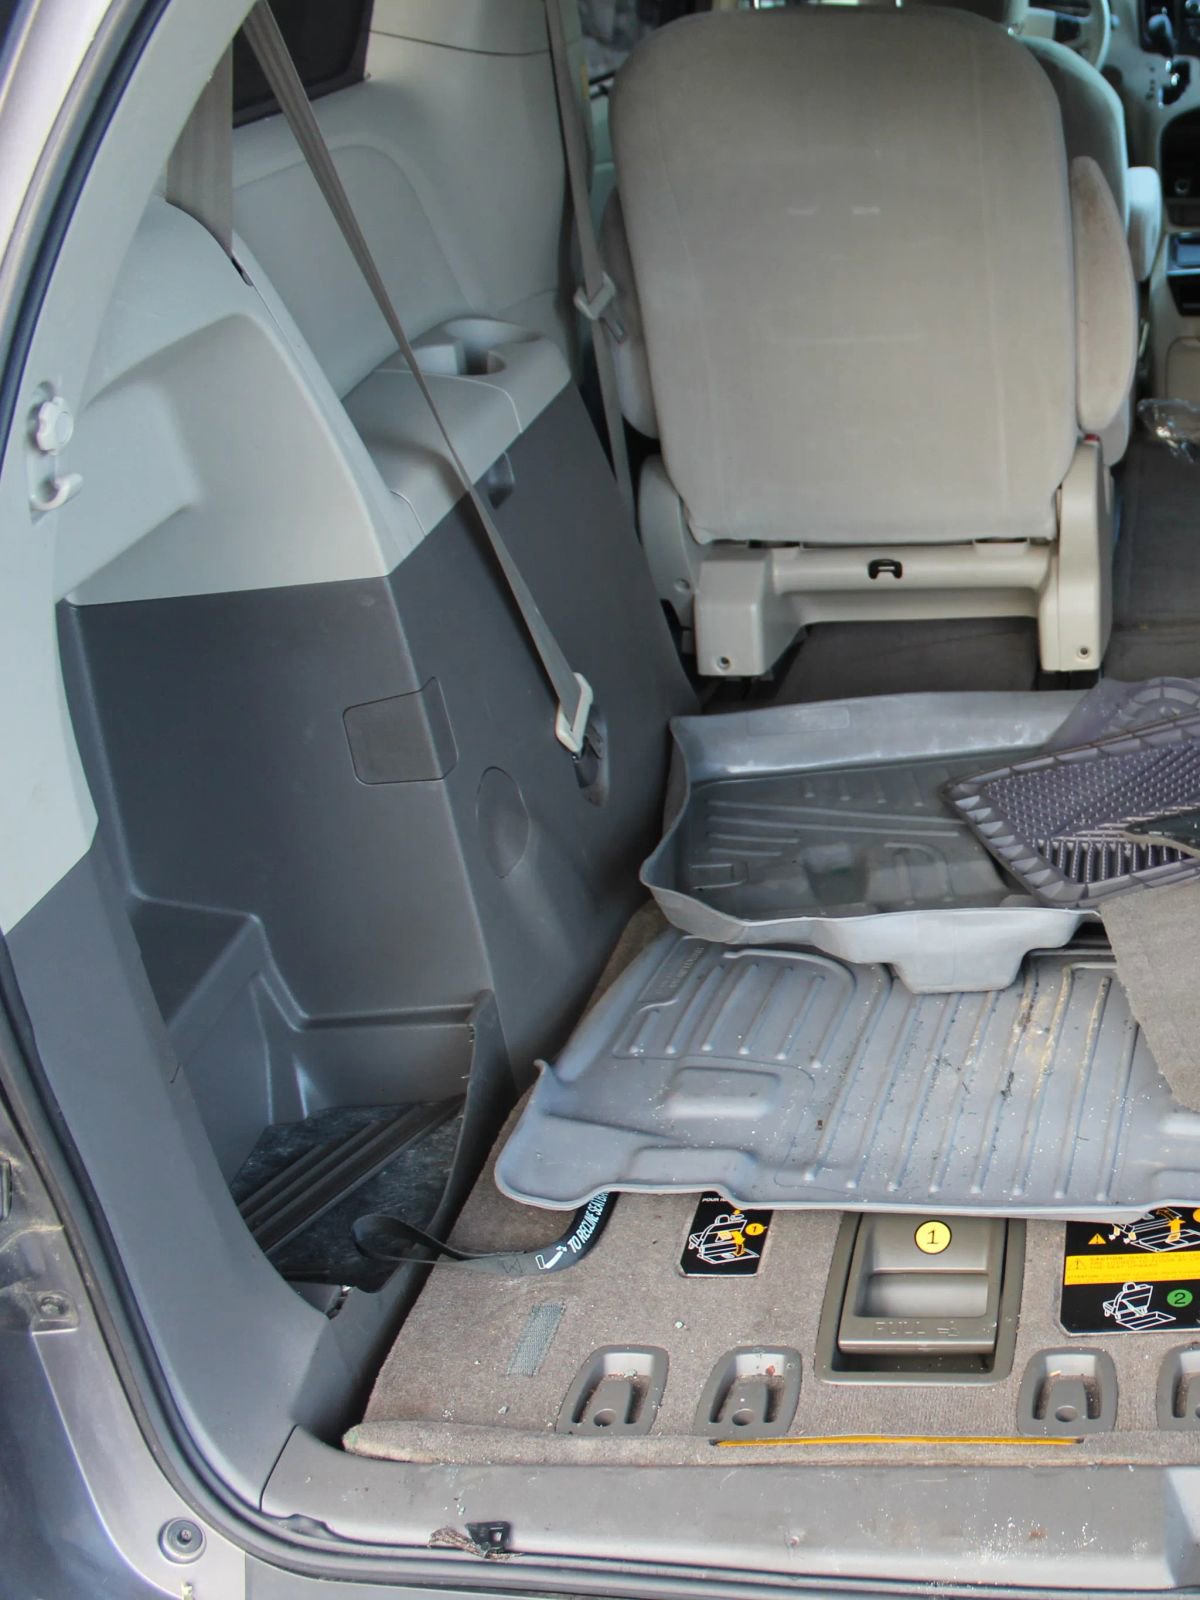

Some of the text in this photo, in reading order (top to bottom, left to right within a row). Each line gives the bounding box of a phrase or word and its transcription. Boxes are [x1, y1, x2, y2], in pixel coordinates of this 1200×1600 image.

[567, 1235, 582, 1254] TO
[576, 1210, 599, 1244] RECLINE
[927, 1229, 939, 1245] 1
[1174, 1292, 1186, 1305] 2
